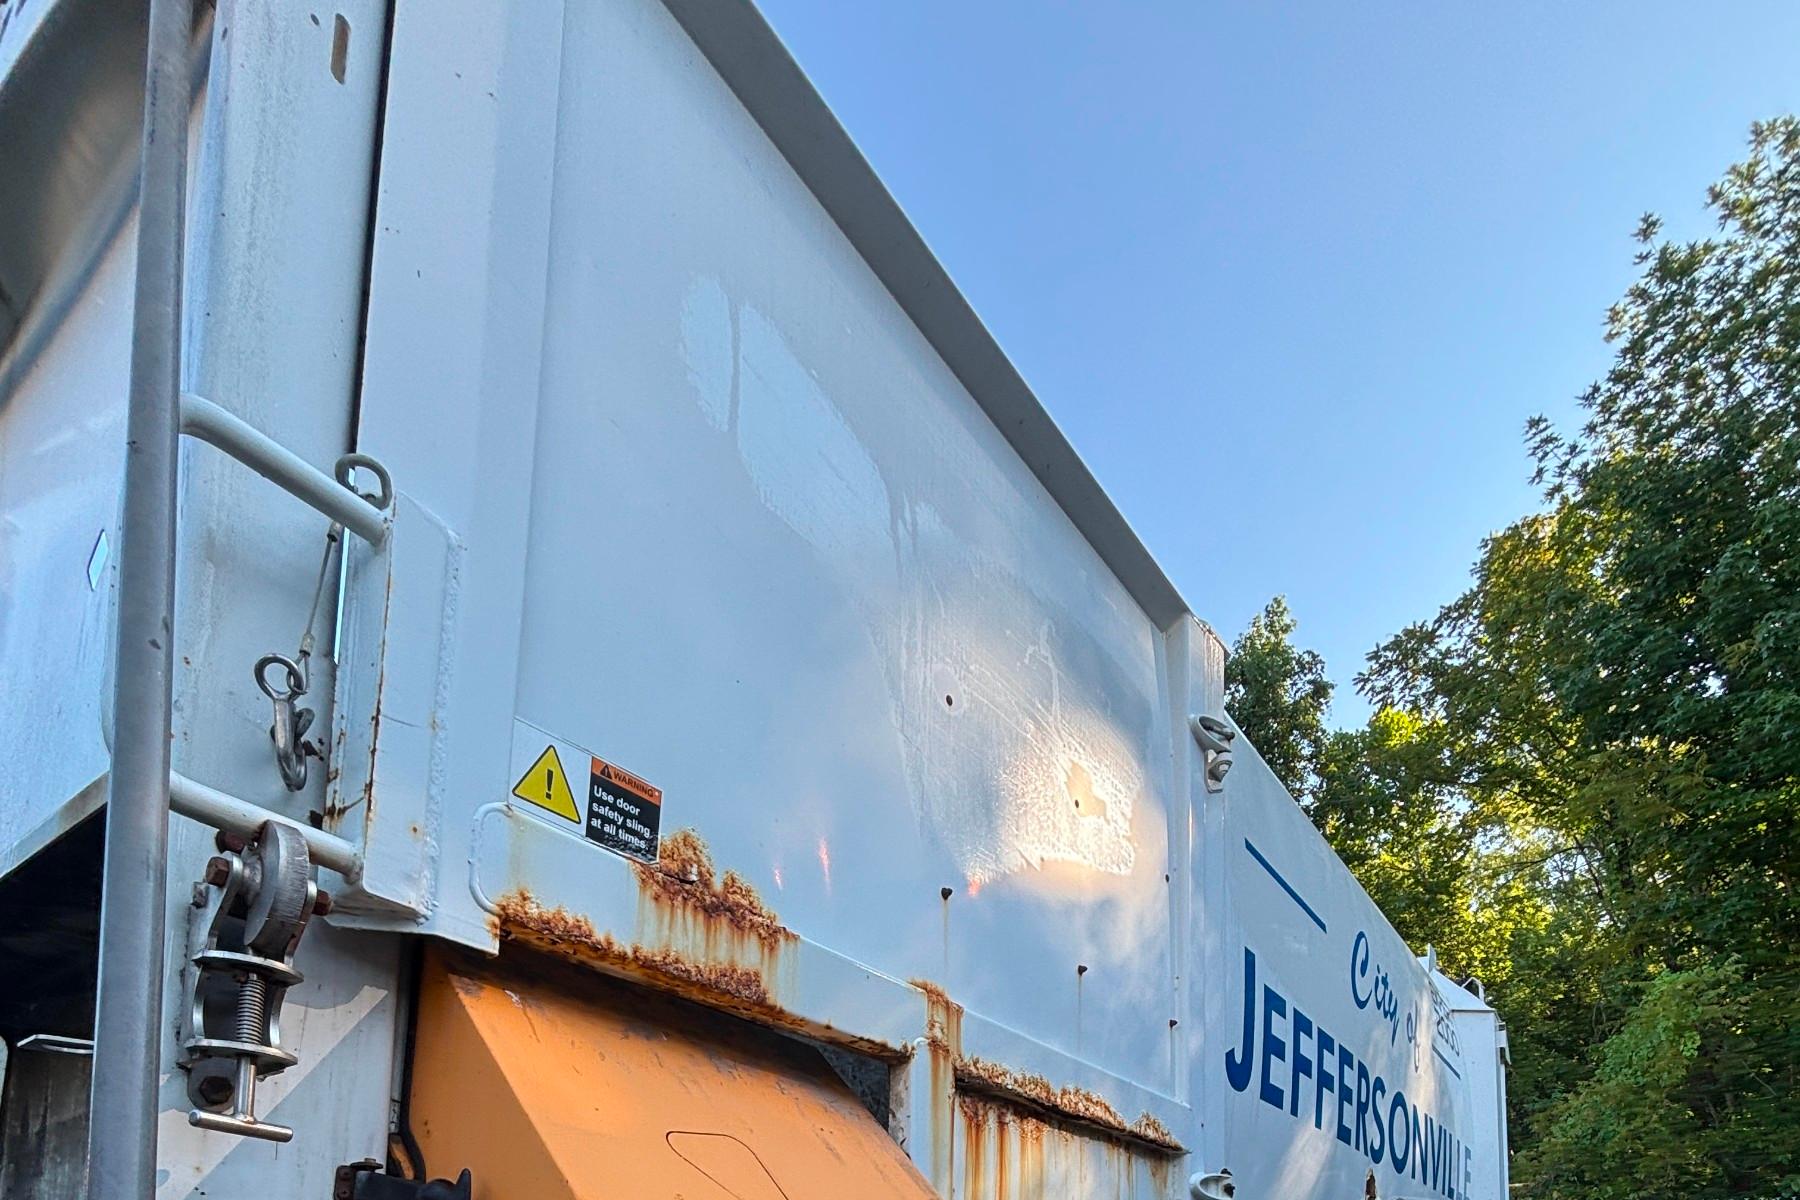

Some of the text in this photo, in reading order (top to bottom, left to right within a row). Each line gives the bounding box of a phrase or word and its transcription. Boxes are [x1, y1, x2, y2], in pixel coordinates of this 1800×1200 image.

[613, 770, 654, 798] WARNING
[593, 785, 641, 816] Use door
[590, 817, 602, 829] at
[603, 823, 616, 836] all
[592, 802, 650, 838] safety sling
[1350, 930, 1421, 1074] City of
